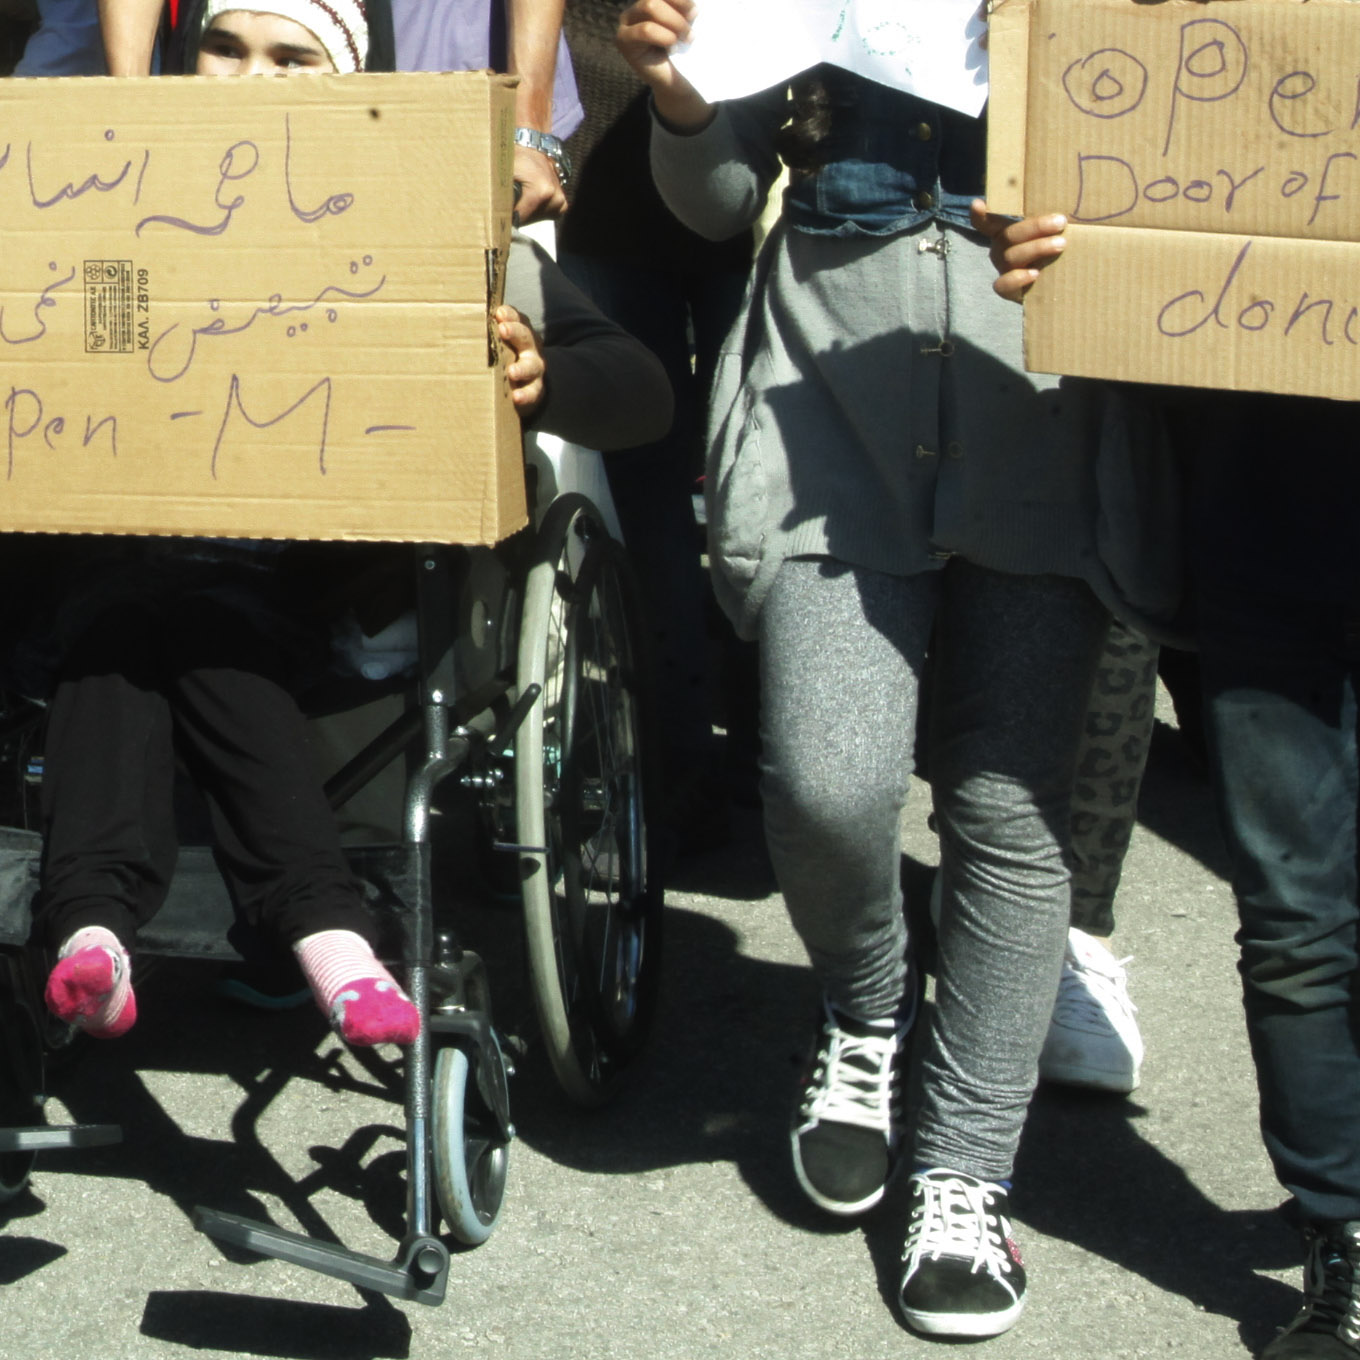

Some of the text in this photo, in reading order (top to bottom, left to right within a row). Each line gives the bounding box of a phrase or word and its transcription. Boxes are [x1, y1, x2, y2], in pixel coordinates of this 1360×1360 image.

[1070, 151, 1358, 226] Door of
[136, 269, 149, 350] ΚΑΛ. ZB709
